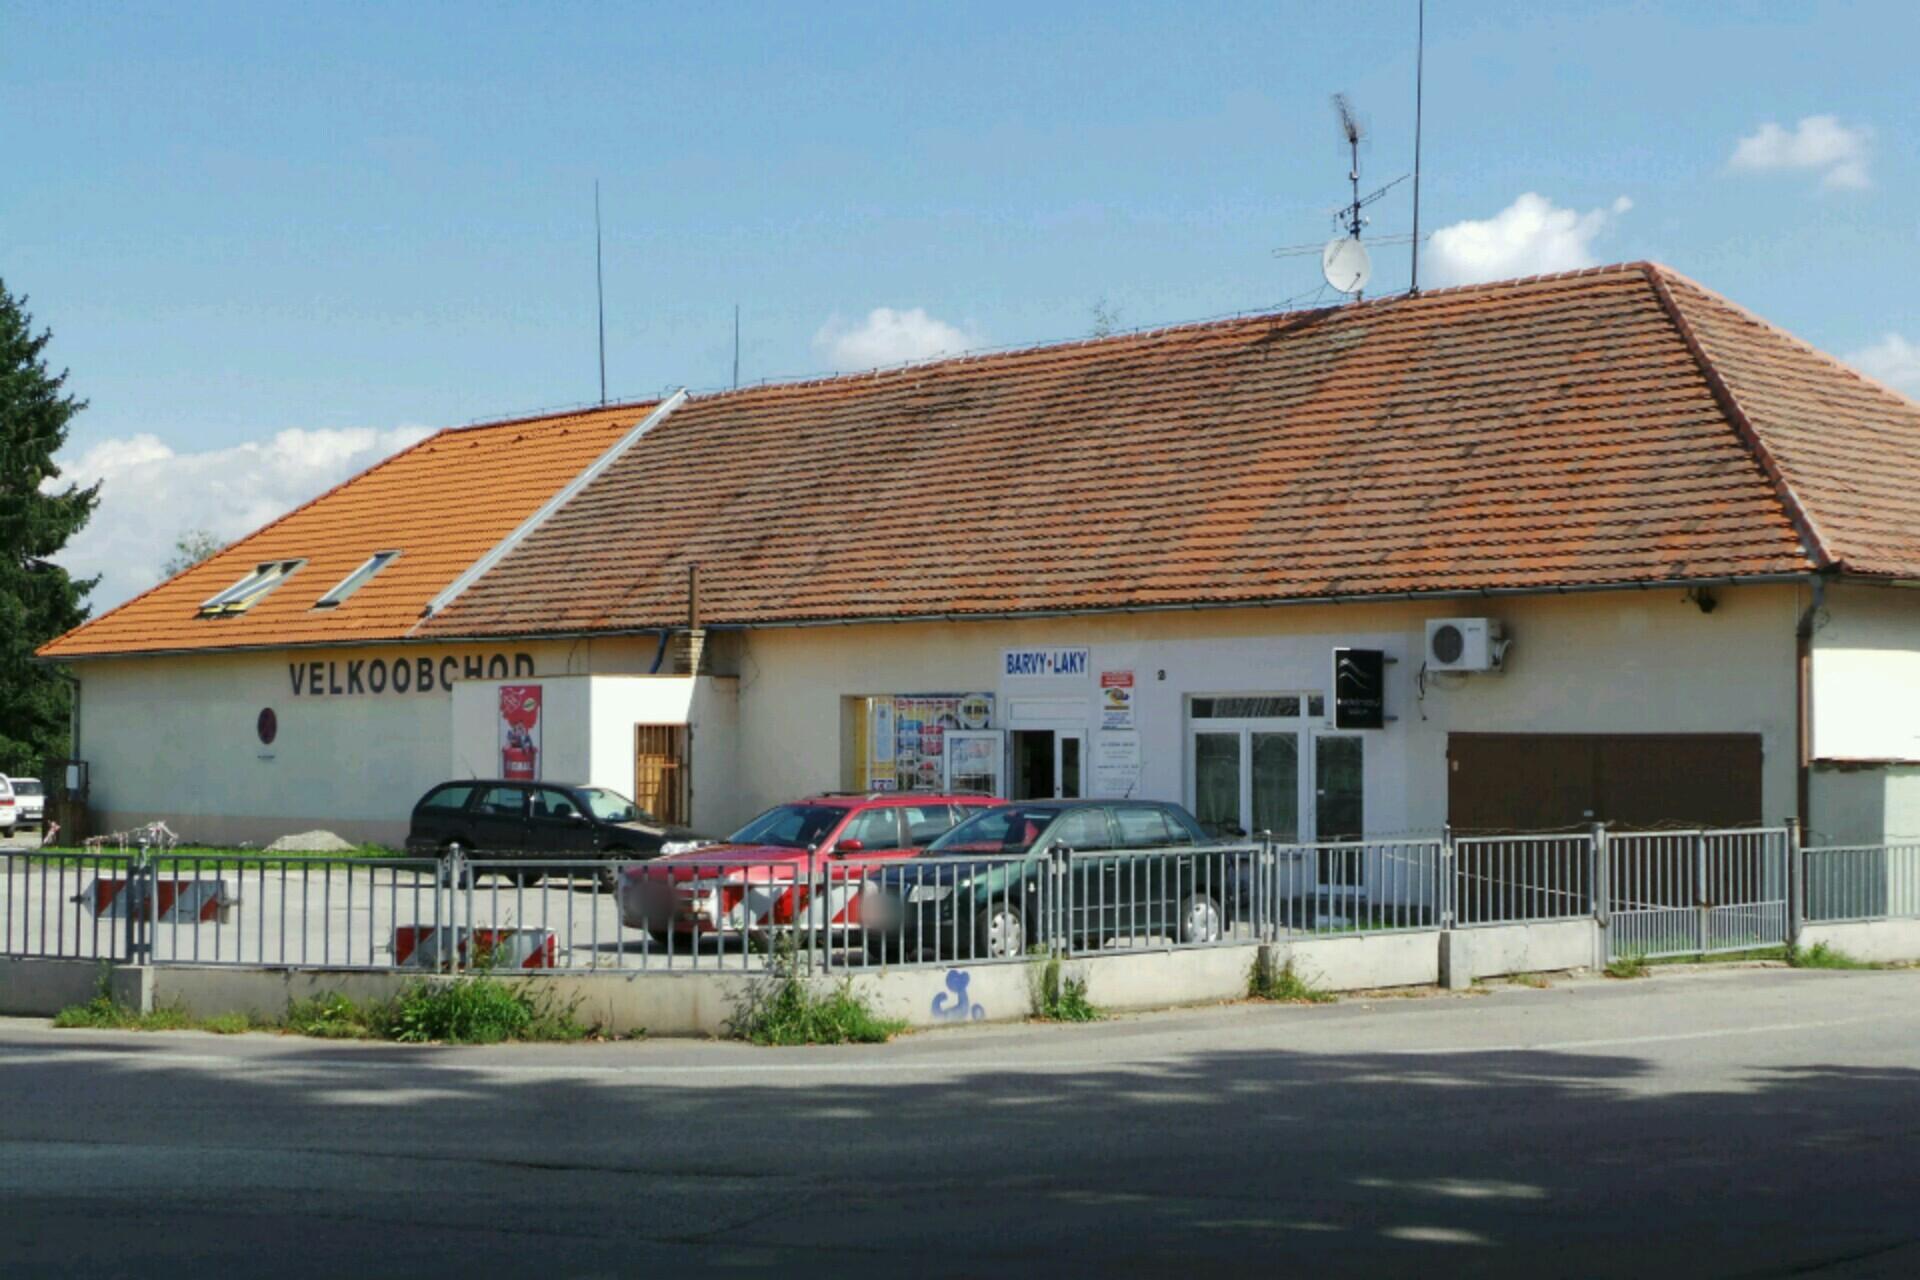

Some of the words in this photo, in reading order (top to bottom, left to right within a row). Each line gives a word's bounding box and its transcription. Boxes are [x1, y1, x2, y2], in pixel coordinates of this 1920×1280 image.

[289, 653, 535, 695] VELKOOBCHOD
[1006, 652, 1047, 674] BARVY
[1054, 651, 1087, 673] LAKY
